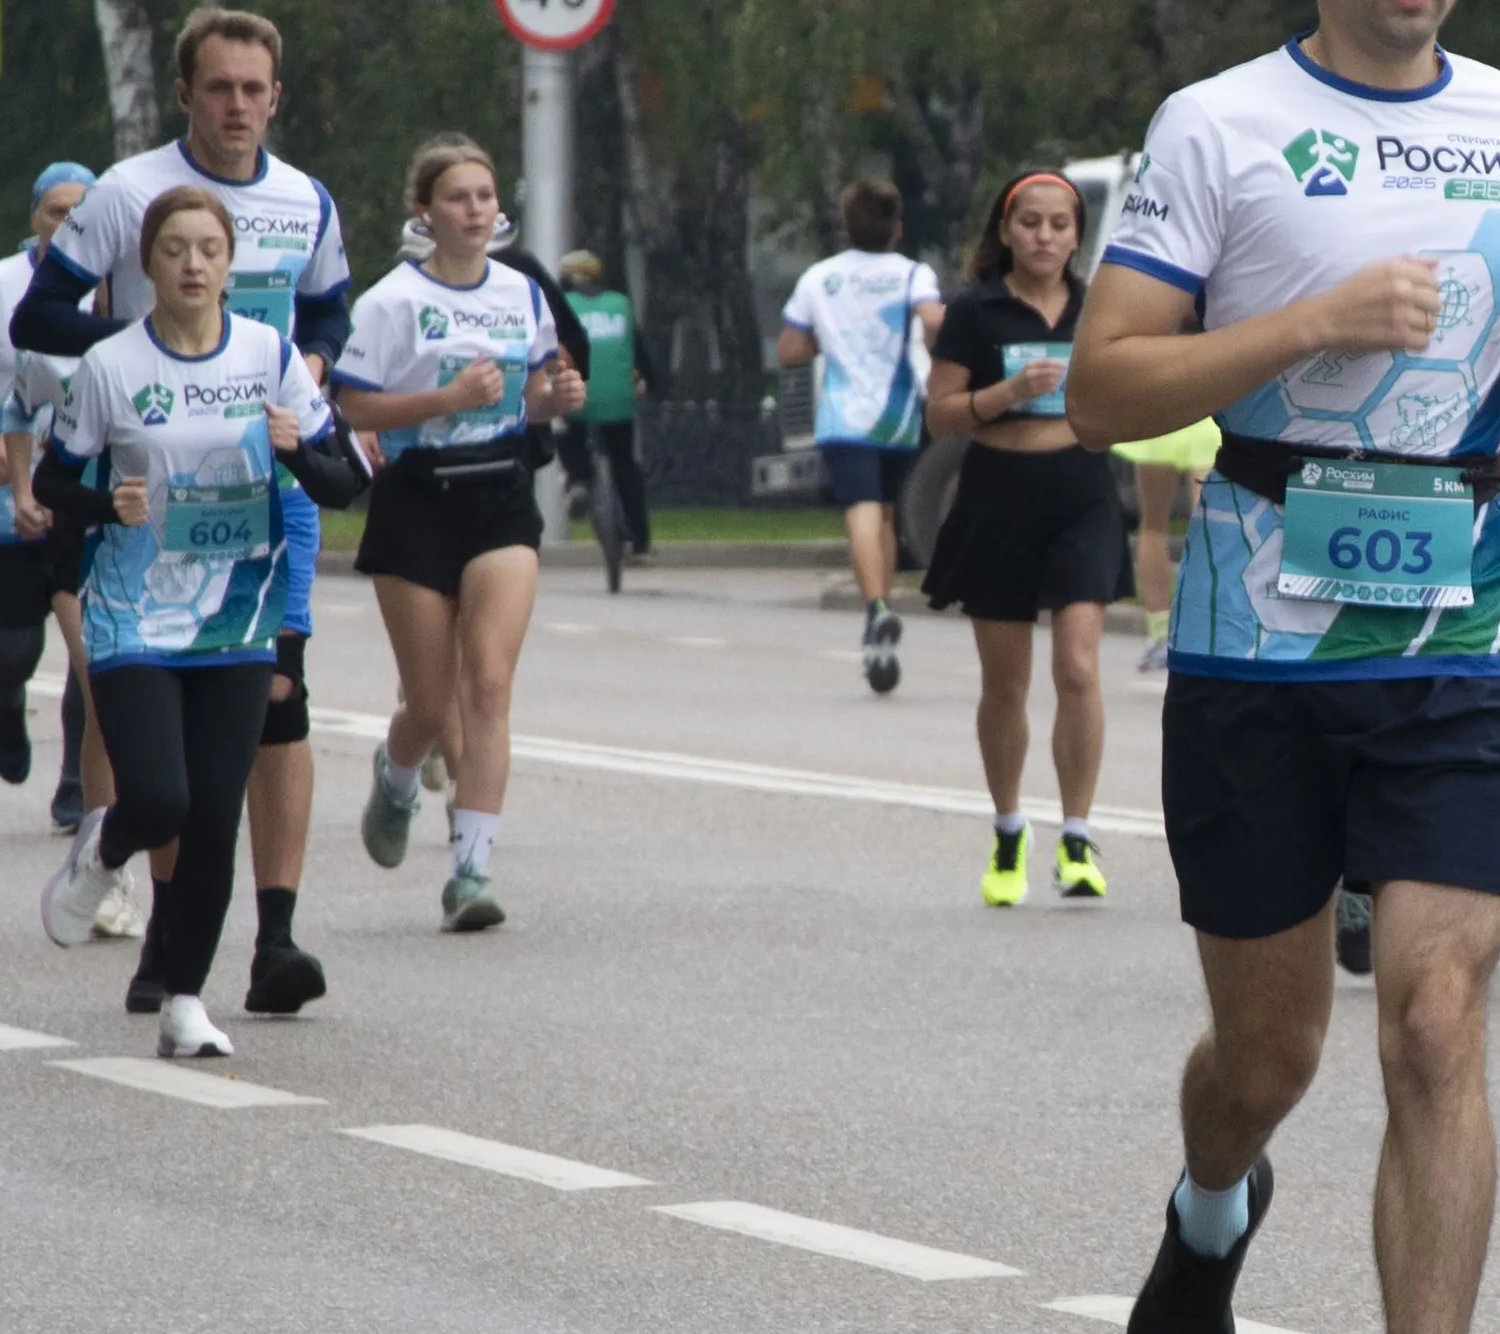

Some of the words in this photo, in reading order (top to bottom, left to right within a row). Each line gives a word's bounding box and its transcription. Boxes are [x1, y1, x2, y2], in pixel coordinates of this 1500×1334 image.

[1382, 175, 1437, 190] 2025
[233, 215, 309, 236] осхим
[1433, 477, 1444, 492] 5
[1358, 506, 1412, 522] РАФИС
[190, 519, 253, 546] 604
[1328, 525, 1433, 575] 603
